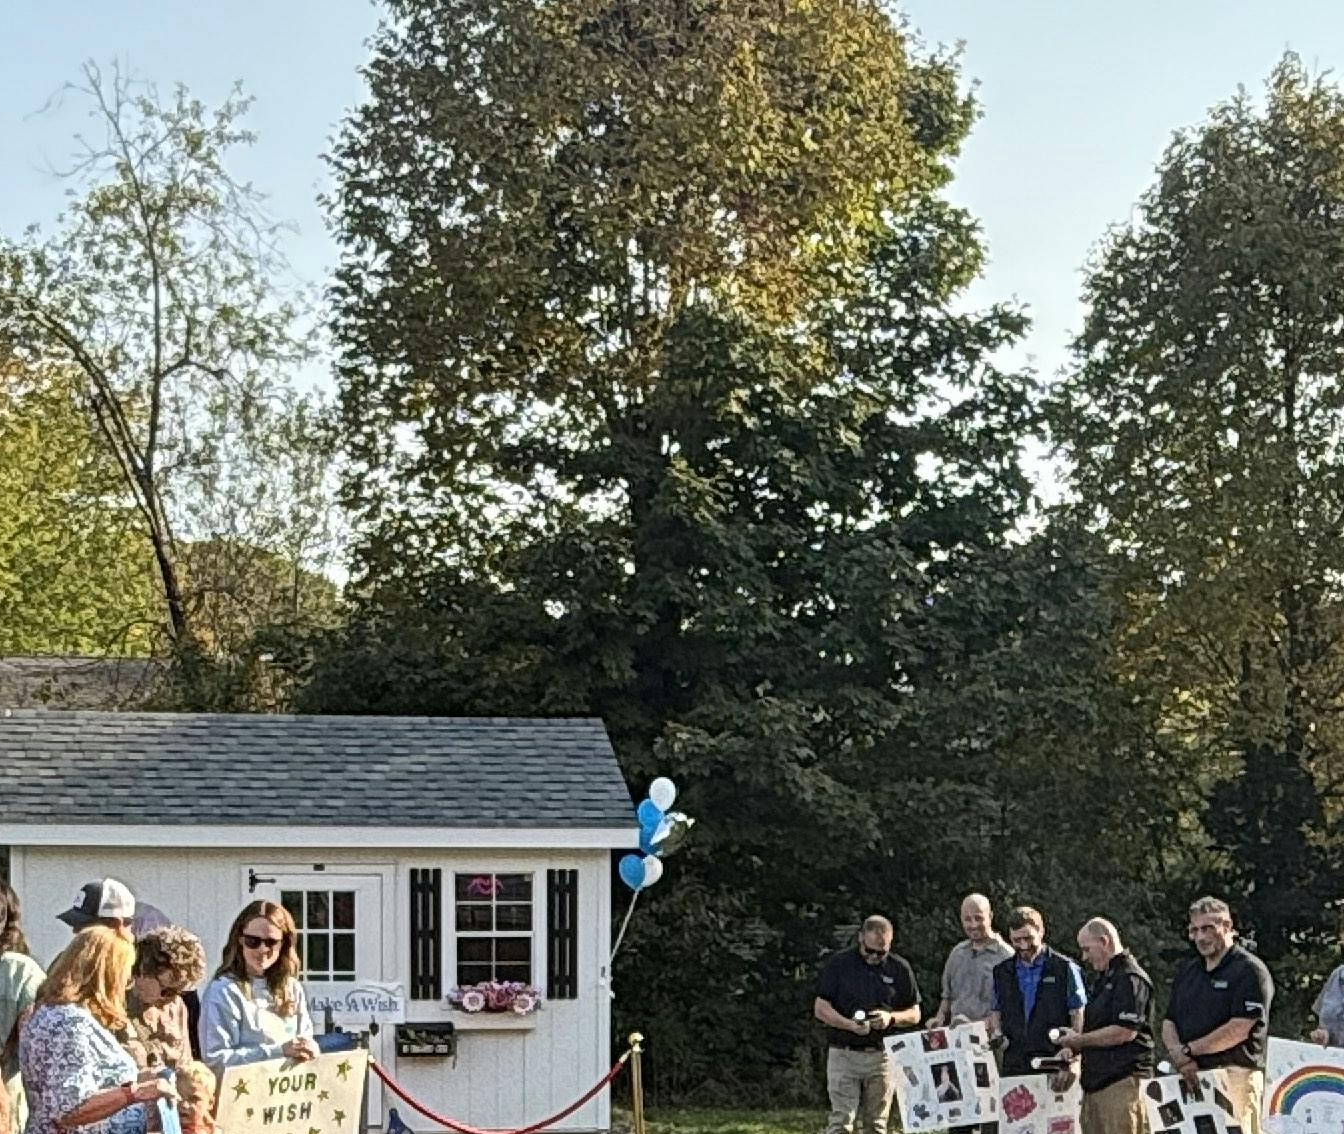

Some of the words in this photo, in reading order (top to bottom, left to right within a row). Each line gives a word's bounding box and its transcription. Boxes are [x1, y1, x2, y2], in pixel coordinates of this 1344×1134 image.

[361, 993, 400, 1012] Wish
[268, 1073, 317, 1096] YOUR
[262, 1101, 312, 1125] WISH
